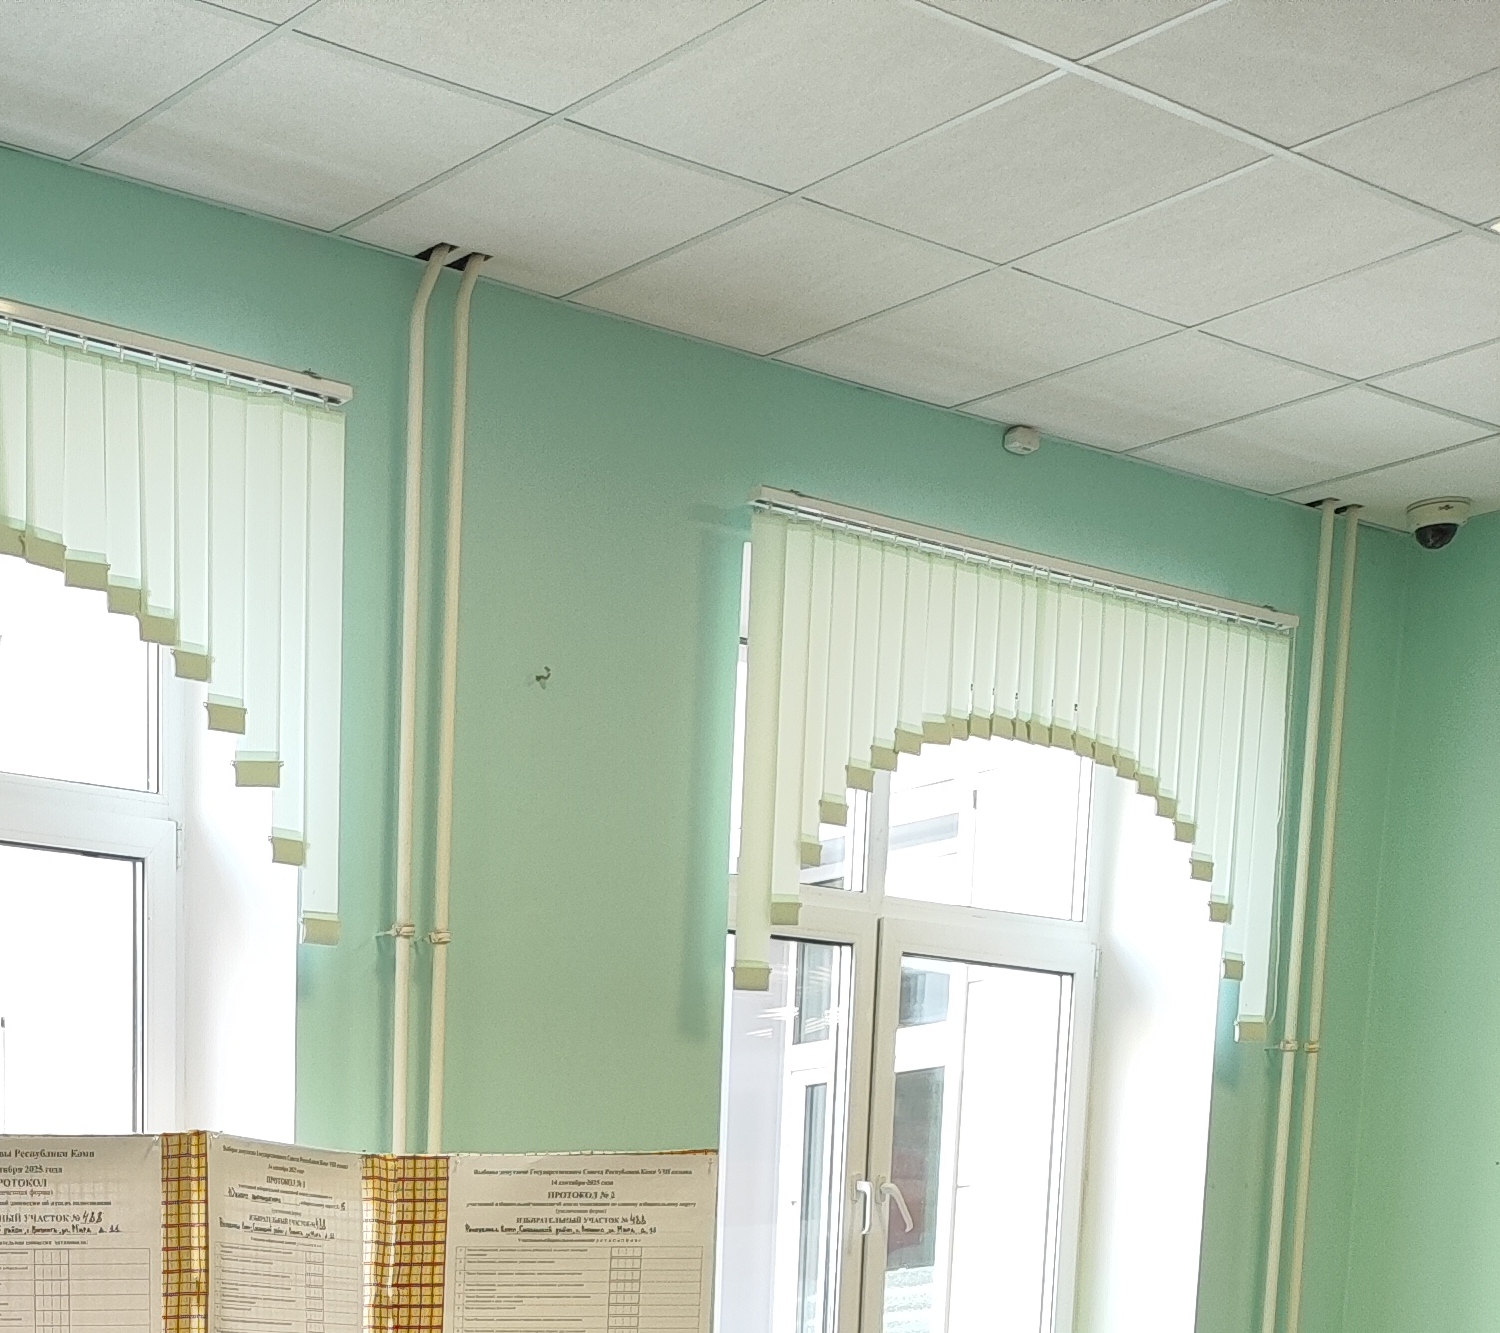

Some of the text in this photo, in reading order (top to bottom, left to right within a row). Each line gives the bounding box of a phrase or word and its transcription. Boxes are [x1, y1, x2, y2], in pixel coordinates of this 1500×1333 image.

[14, 1148, 68, 1160] Республики
[547, 1191, 598, 1199] ПРОТОКОЛ
[23, 1213, 70, 1223] УЧАСТОК
